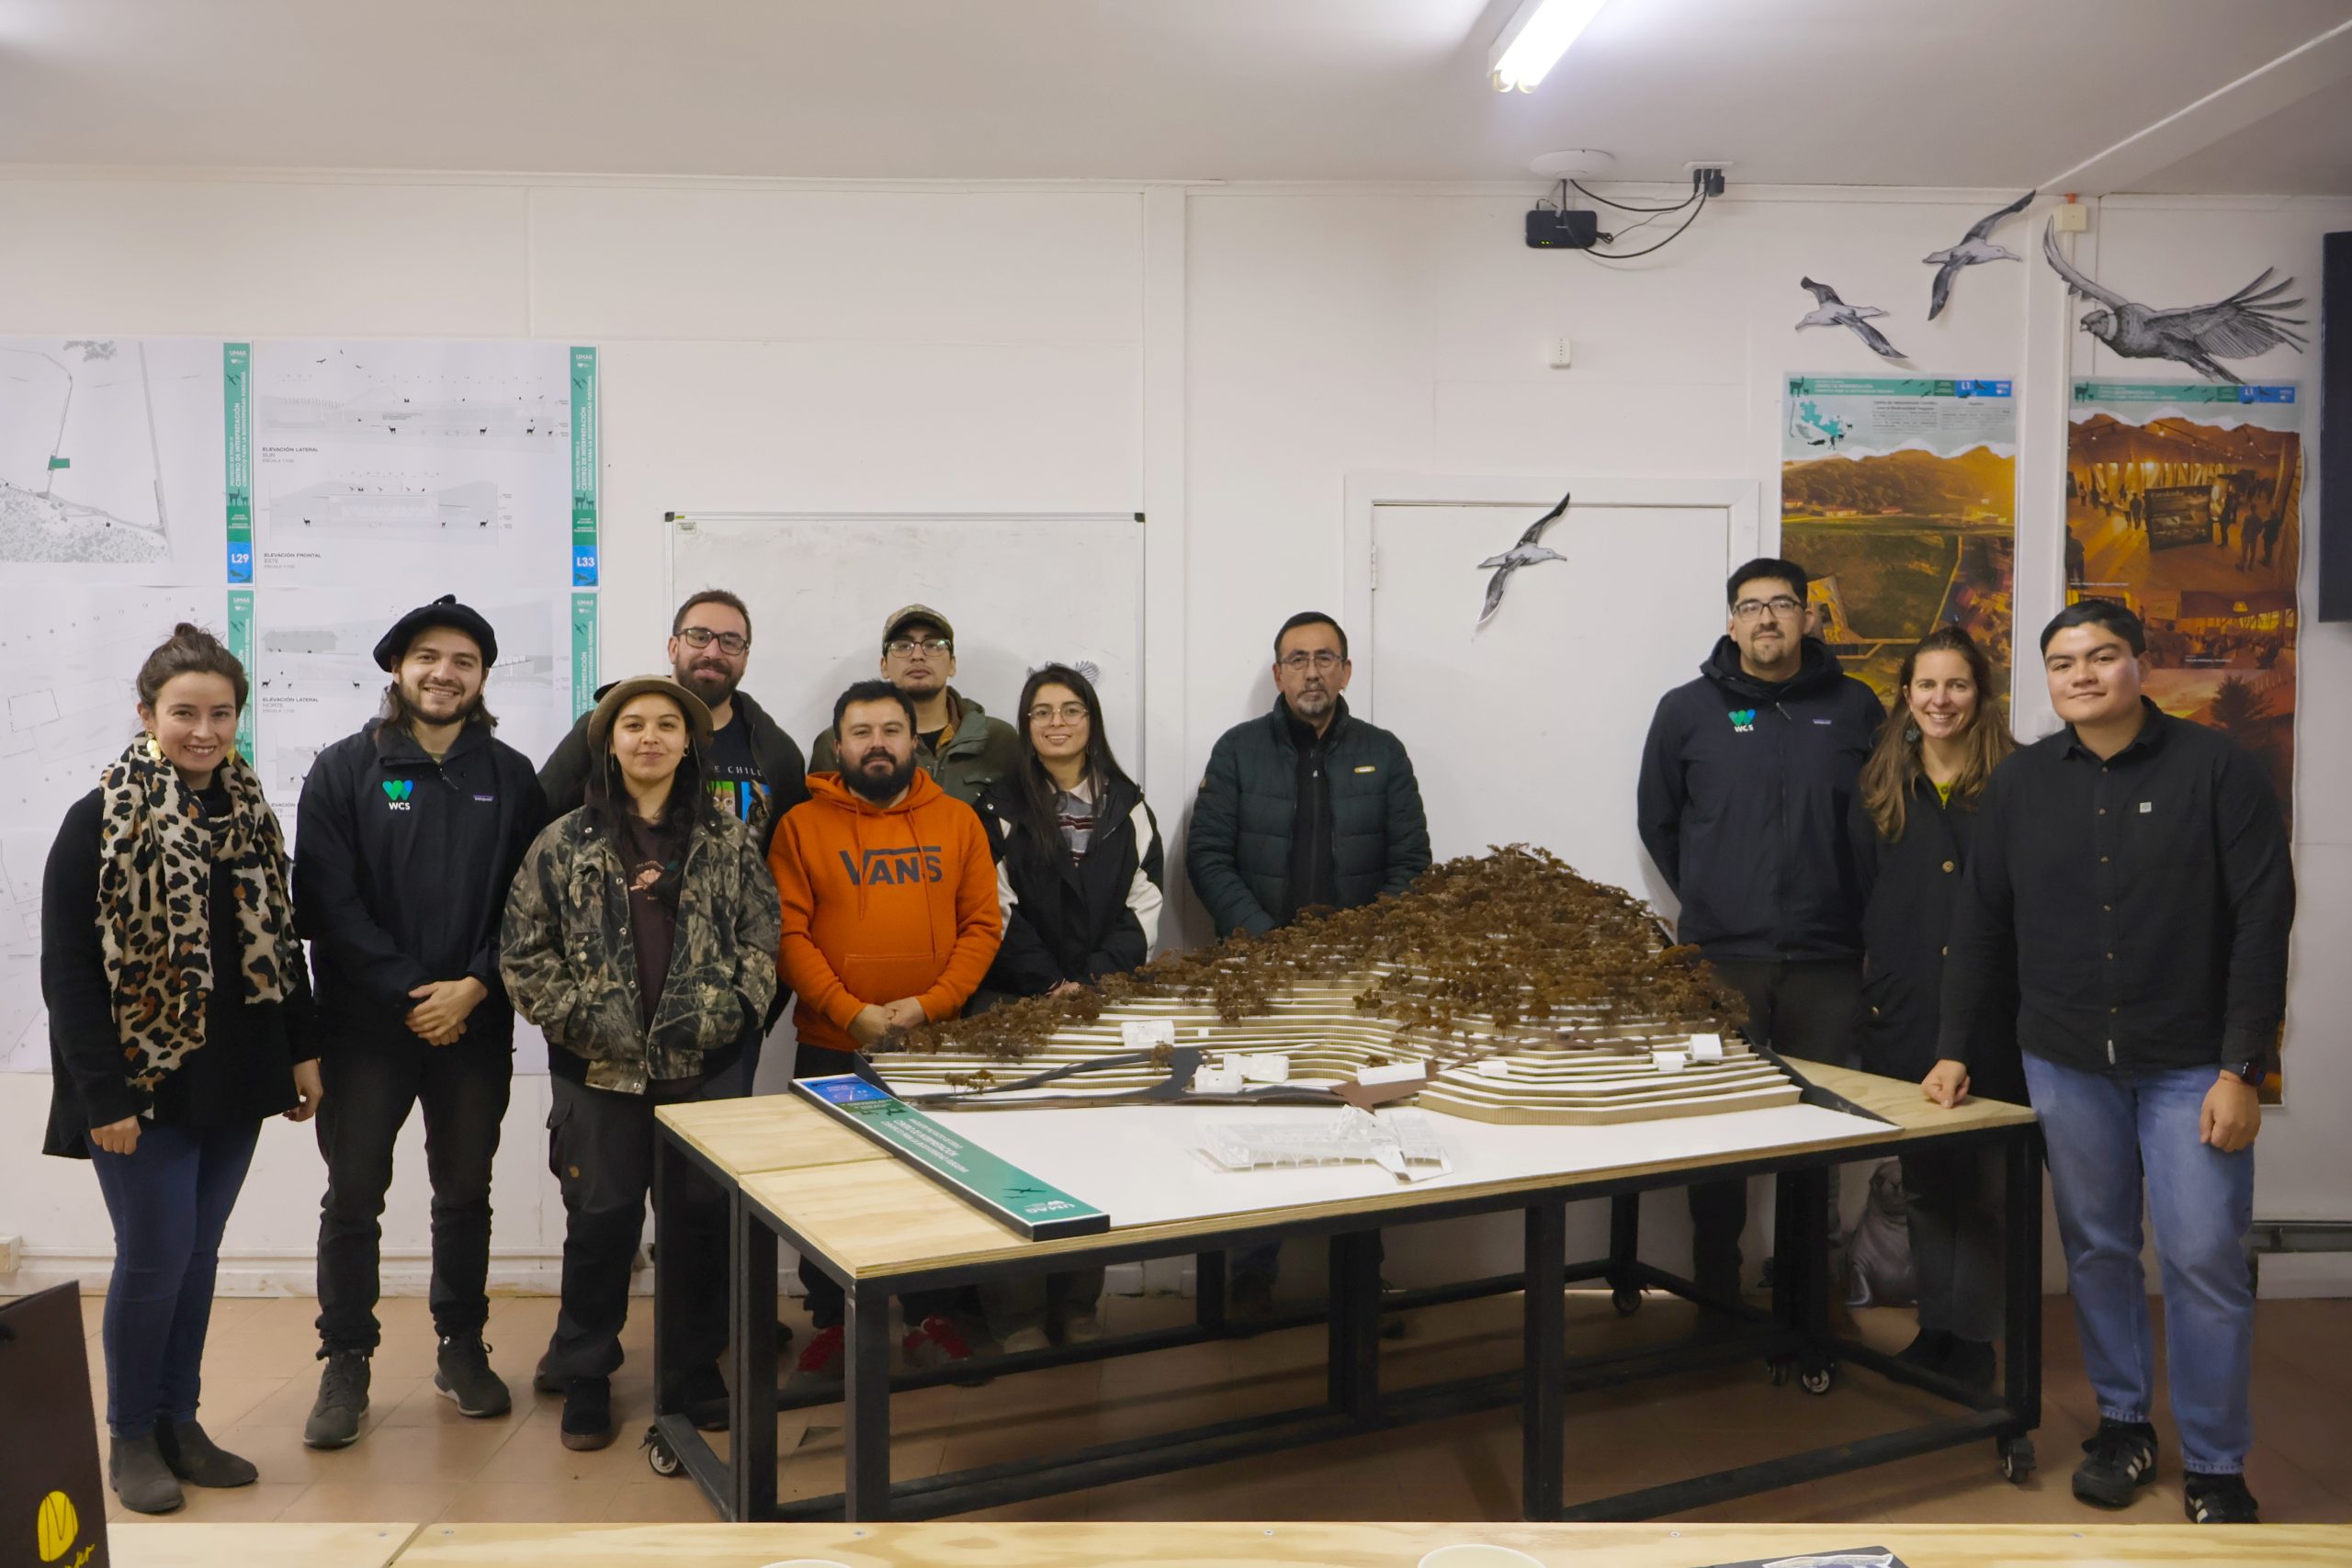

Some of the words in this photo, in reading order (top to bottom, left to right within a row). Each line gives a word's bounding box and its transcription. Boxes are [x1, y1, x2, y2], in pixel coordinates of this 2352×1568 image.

[232, 554, 249, 564] L29
[577, 557, 595, 568] L33
[1735, 725, 1753, 733] WCS
[389, 802, 411, 810] WCS
[838, 845, 943, 886] VANS
